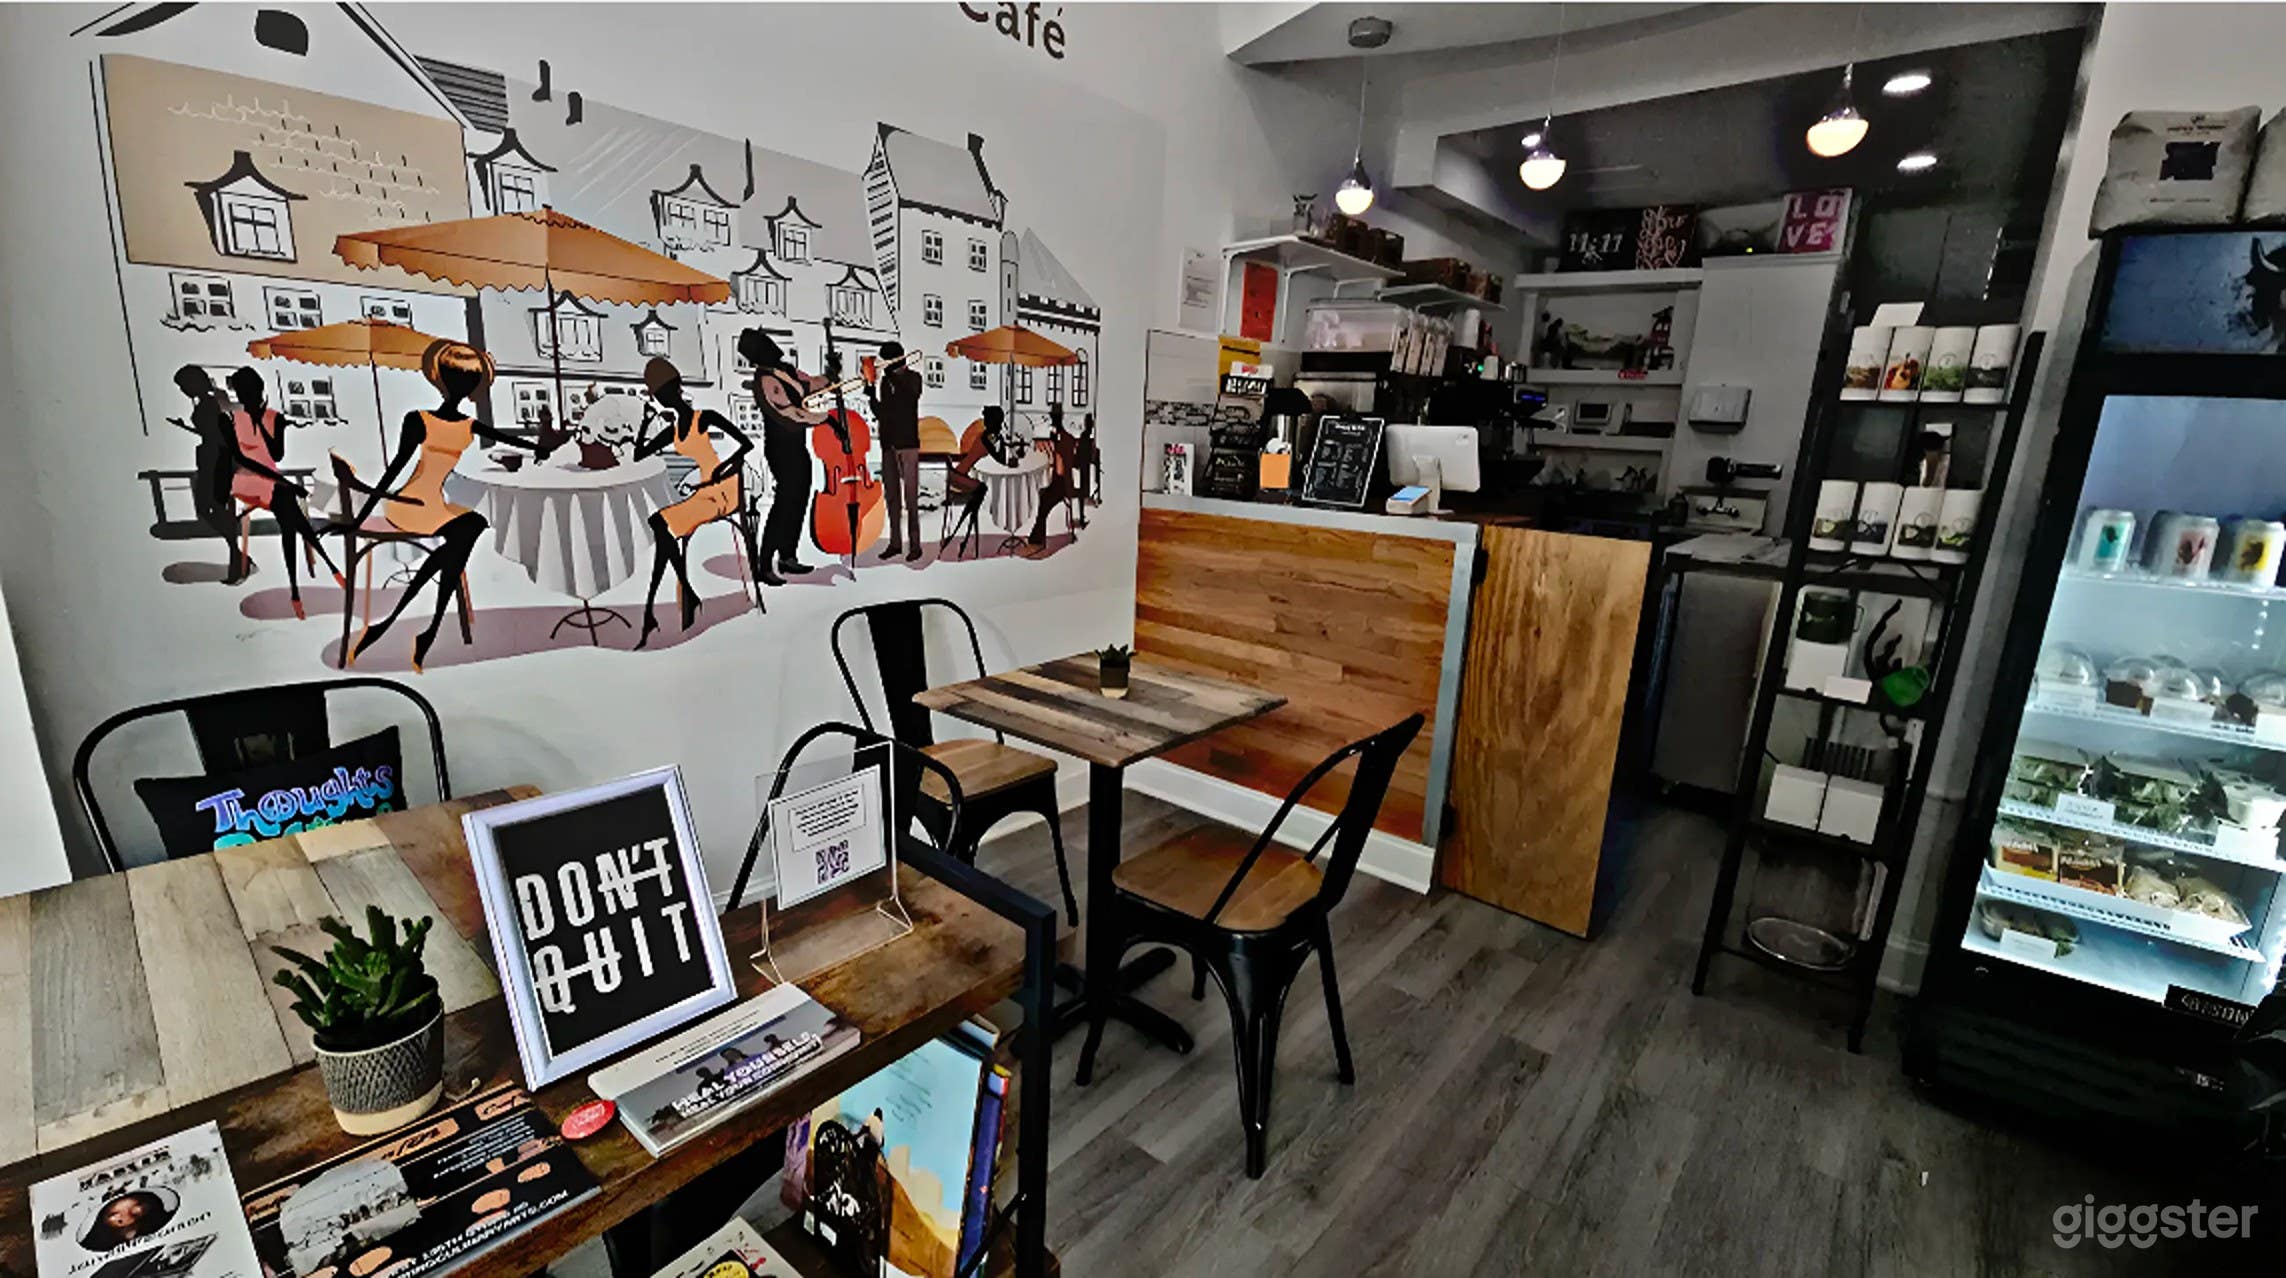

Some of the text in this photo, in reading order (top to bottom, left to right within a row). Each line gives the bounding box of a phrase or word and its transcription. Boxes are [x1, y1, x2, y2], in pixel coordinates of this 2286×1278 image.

[196, 766, 394, 837] Thoughts
[515, 837, 672, 940] DON'T
[533, 902, 691, 1014] QUIT
